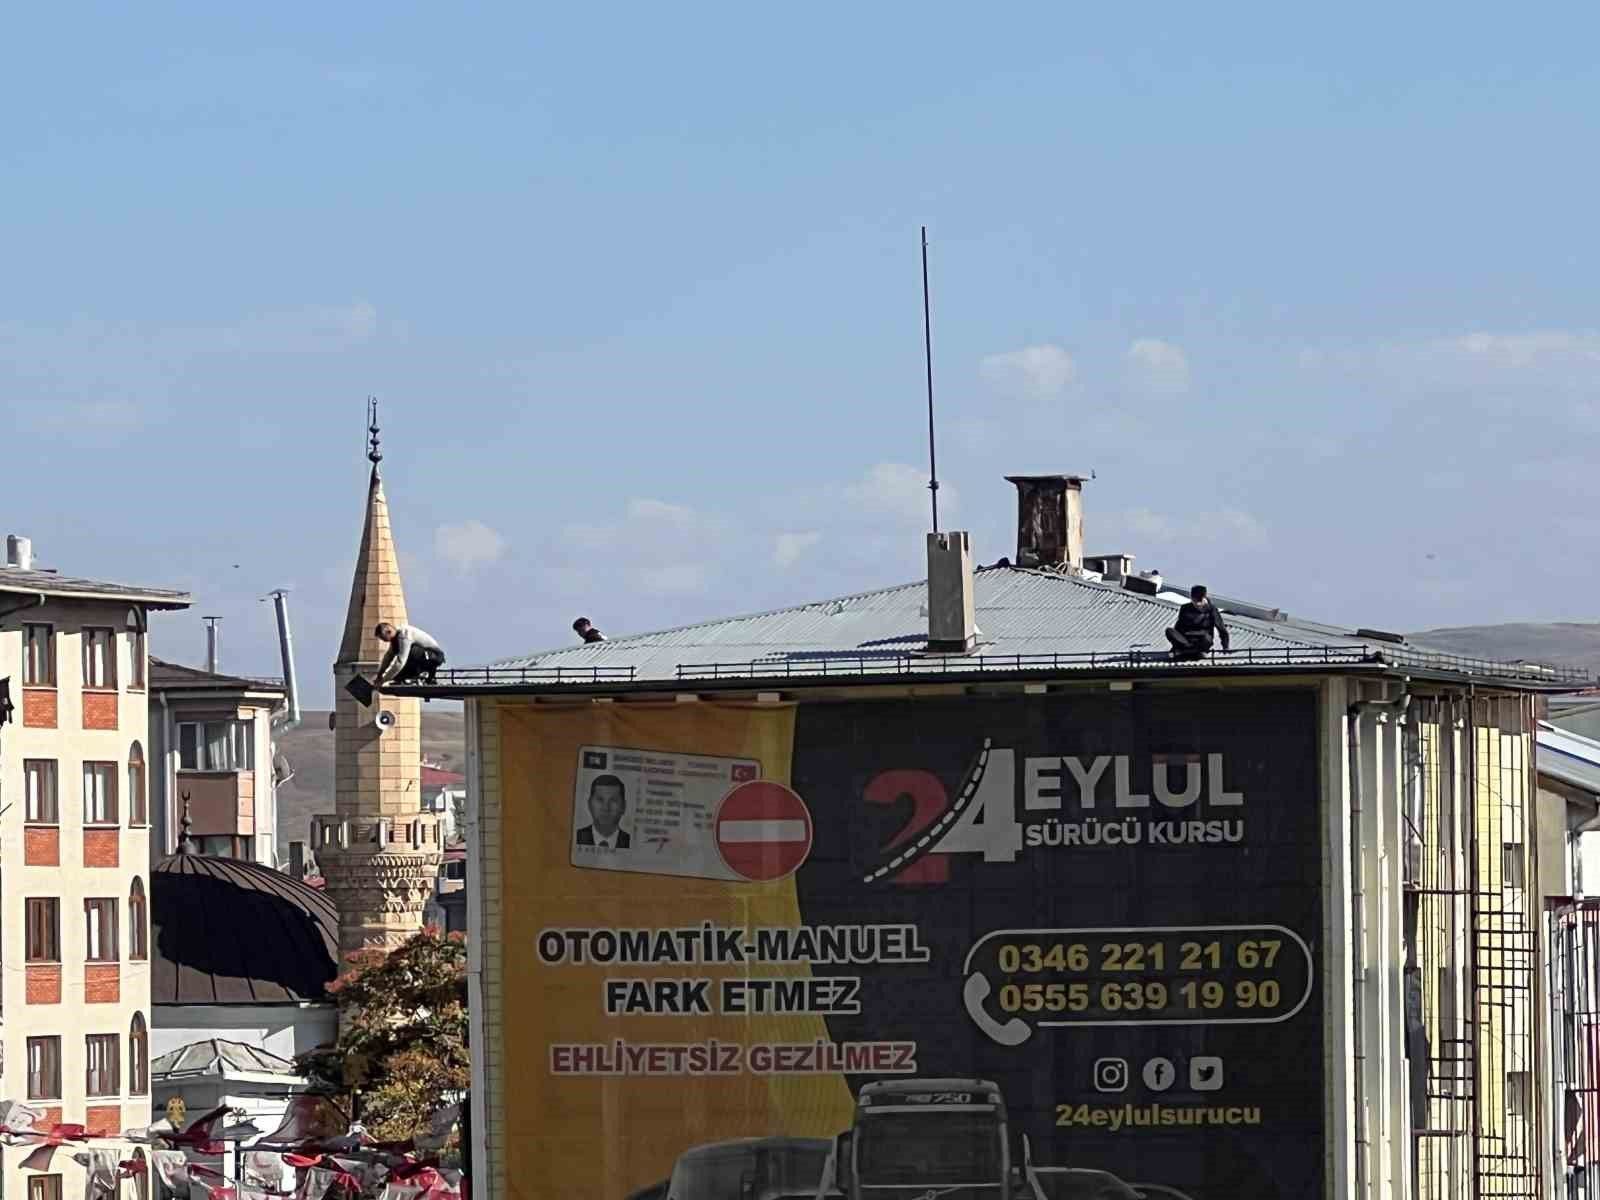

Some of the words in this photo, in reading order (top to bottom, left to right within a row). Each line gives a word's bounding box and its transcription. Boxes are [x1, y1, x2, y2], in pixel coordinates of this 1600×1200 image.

[863, 746, 1023, 884] 24
[1025, 817, 1142, 847] SÜRÜCÜ
[1148, 819, 1245, 845] KURSU
[537, 922, 930, 964] OTOMATİK-MANUEL
[998, 944, 1089, 973] 0346
[1101, 943, 1166, 971] 221
[1179, 942, 1221, 970] 21
[1237, 940, 1282, 969] 67
[605, 979, 711, 1015] FARK
[719, 978, 861, 1015] ETMEZ
[999, 984, 1089, 1012] 0555
[1101, 982, 1167, 1011] 639
[1180, 981, 1224, 1009] 19
[1236, 980, 1281, 1008] 90
[550, 1040, 742, 1076] EHLİYETSİZ
[750, 1039, 917, 1075] GEZİLMEZ
[1055, 1104, 1262, 1132] 24eylulsurucu
